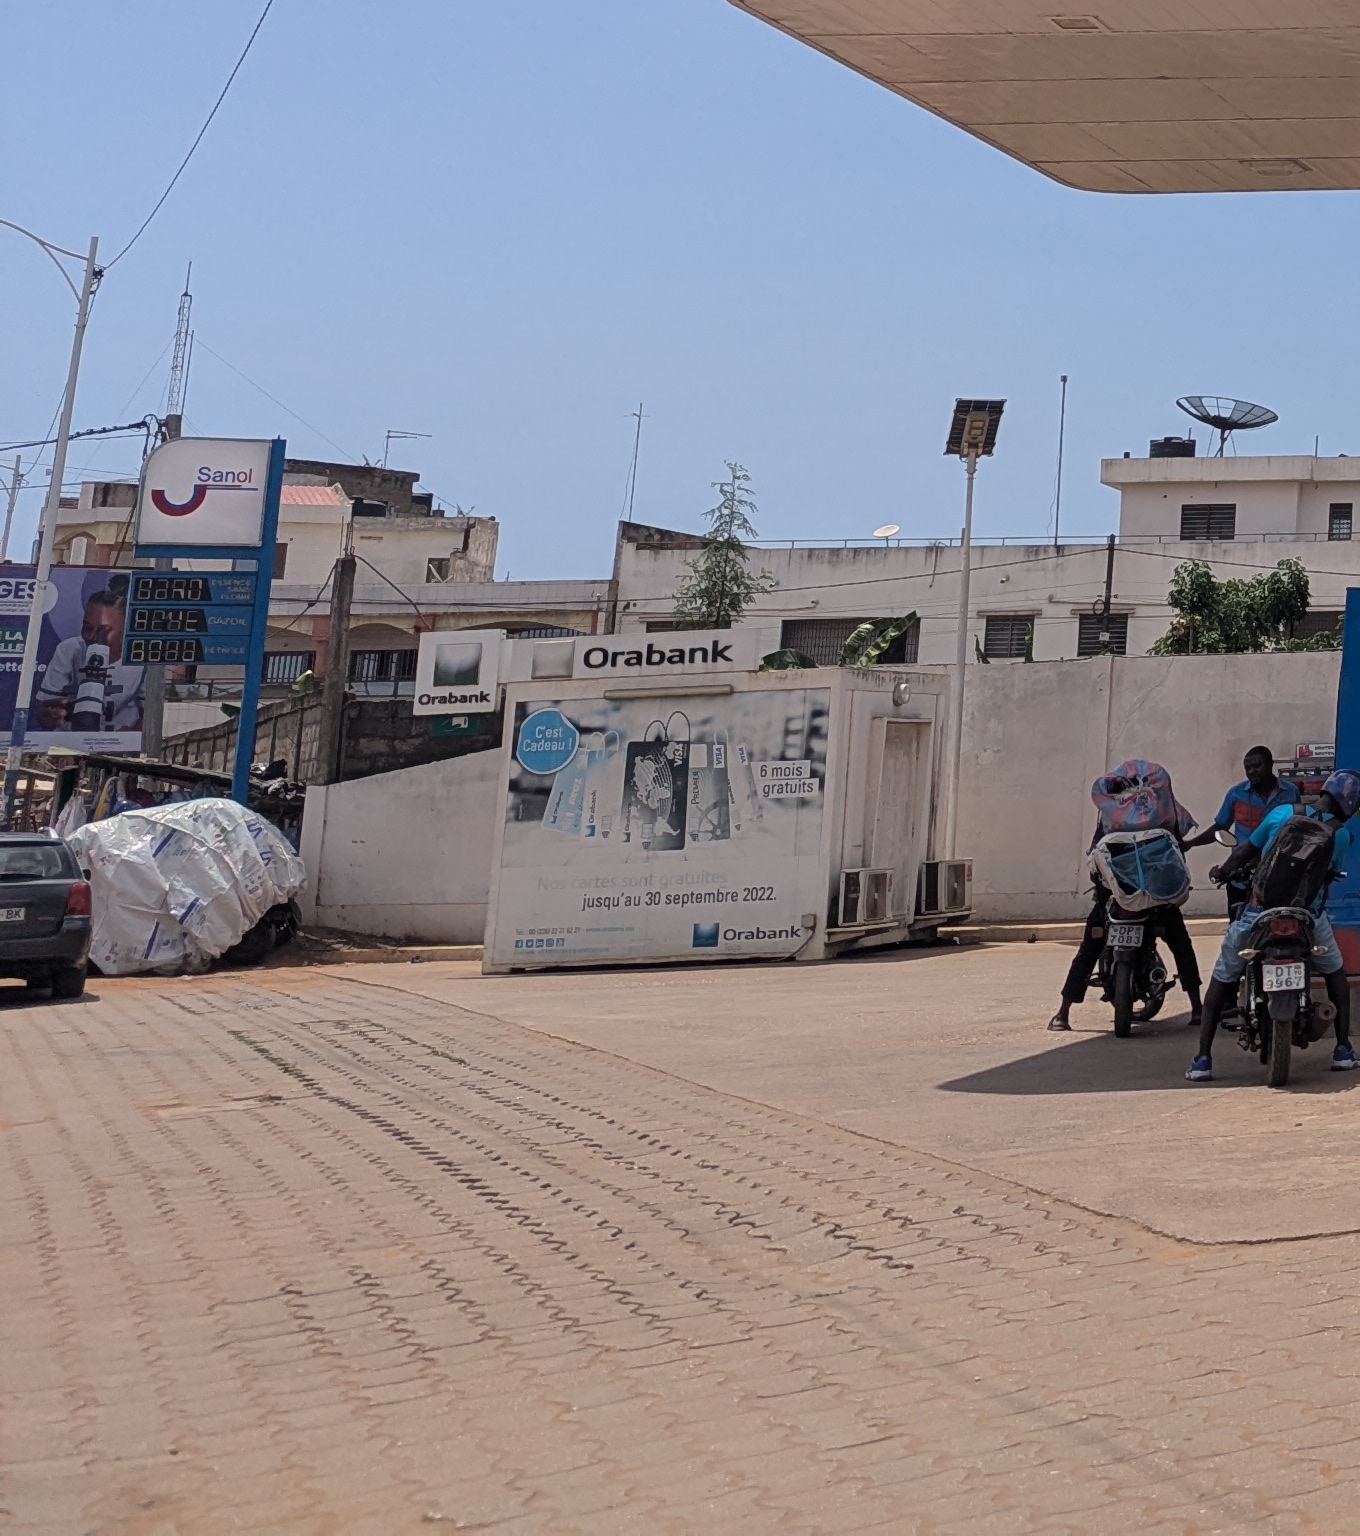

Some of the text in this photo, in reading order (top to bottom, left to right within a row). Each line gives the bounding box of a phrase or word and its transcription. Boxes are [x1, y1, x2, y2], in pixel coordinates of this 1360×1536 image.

[197, 466, 252, 483] Sanol
[5, 631, 24, 640] LA
[583, 640, 733, 669] Orabank
[418, 691, 490, 706] Orabank
[535, 726, 563, 739] C'est
[523, 739, 565, 752] Cadeau
[674, 743, 683, 767] VISA
[715, 747, 723, 765] VISA
[760, 763, 803, 778] 6 mois
[763, 780, 814, 797] gratuits
[538, 870, 728, 891] Nos cartes sont gratuites
[582, 886, 777, 911] jusqu'au 30 septembre 2022.
[6, 909, 21, 919] BK
[723, 926, 802, 941] Orabank
[1119, 926, 1134, 935] DP
[1110, 935, 1140, 944] 7083
[1275, 965, 1293, 977] DT
[1265, 976, 1302, 989] 9967
